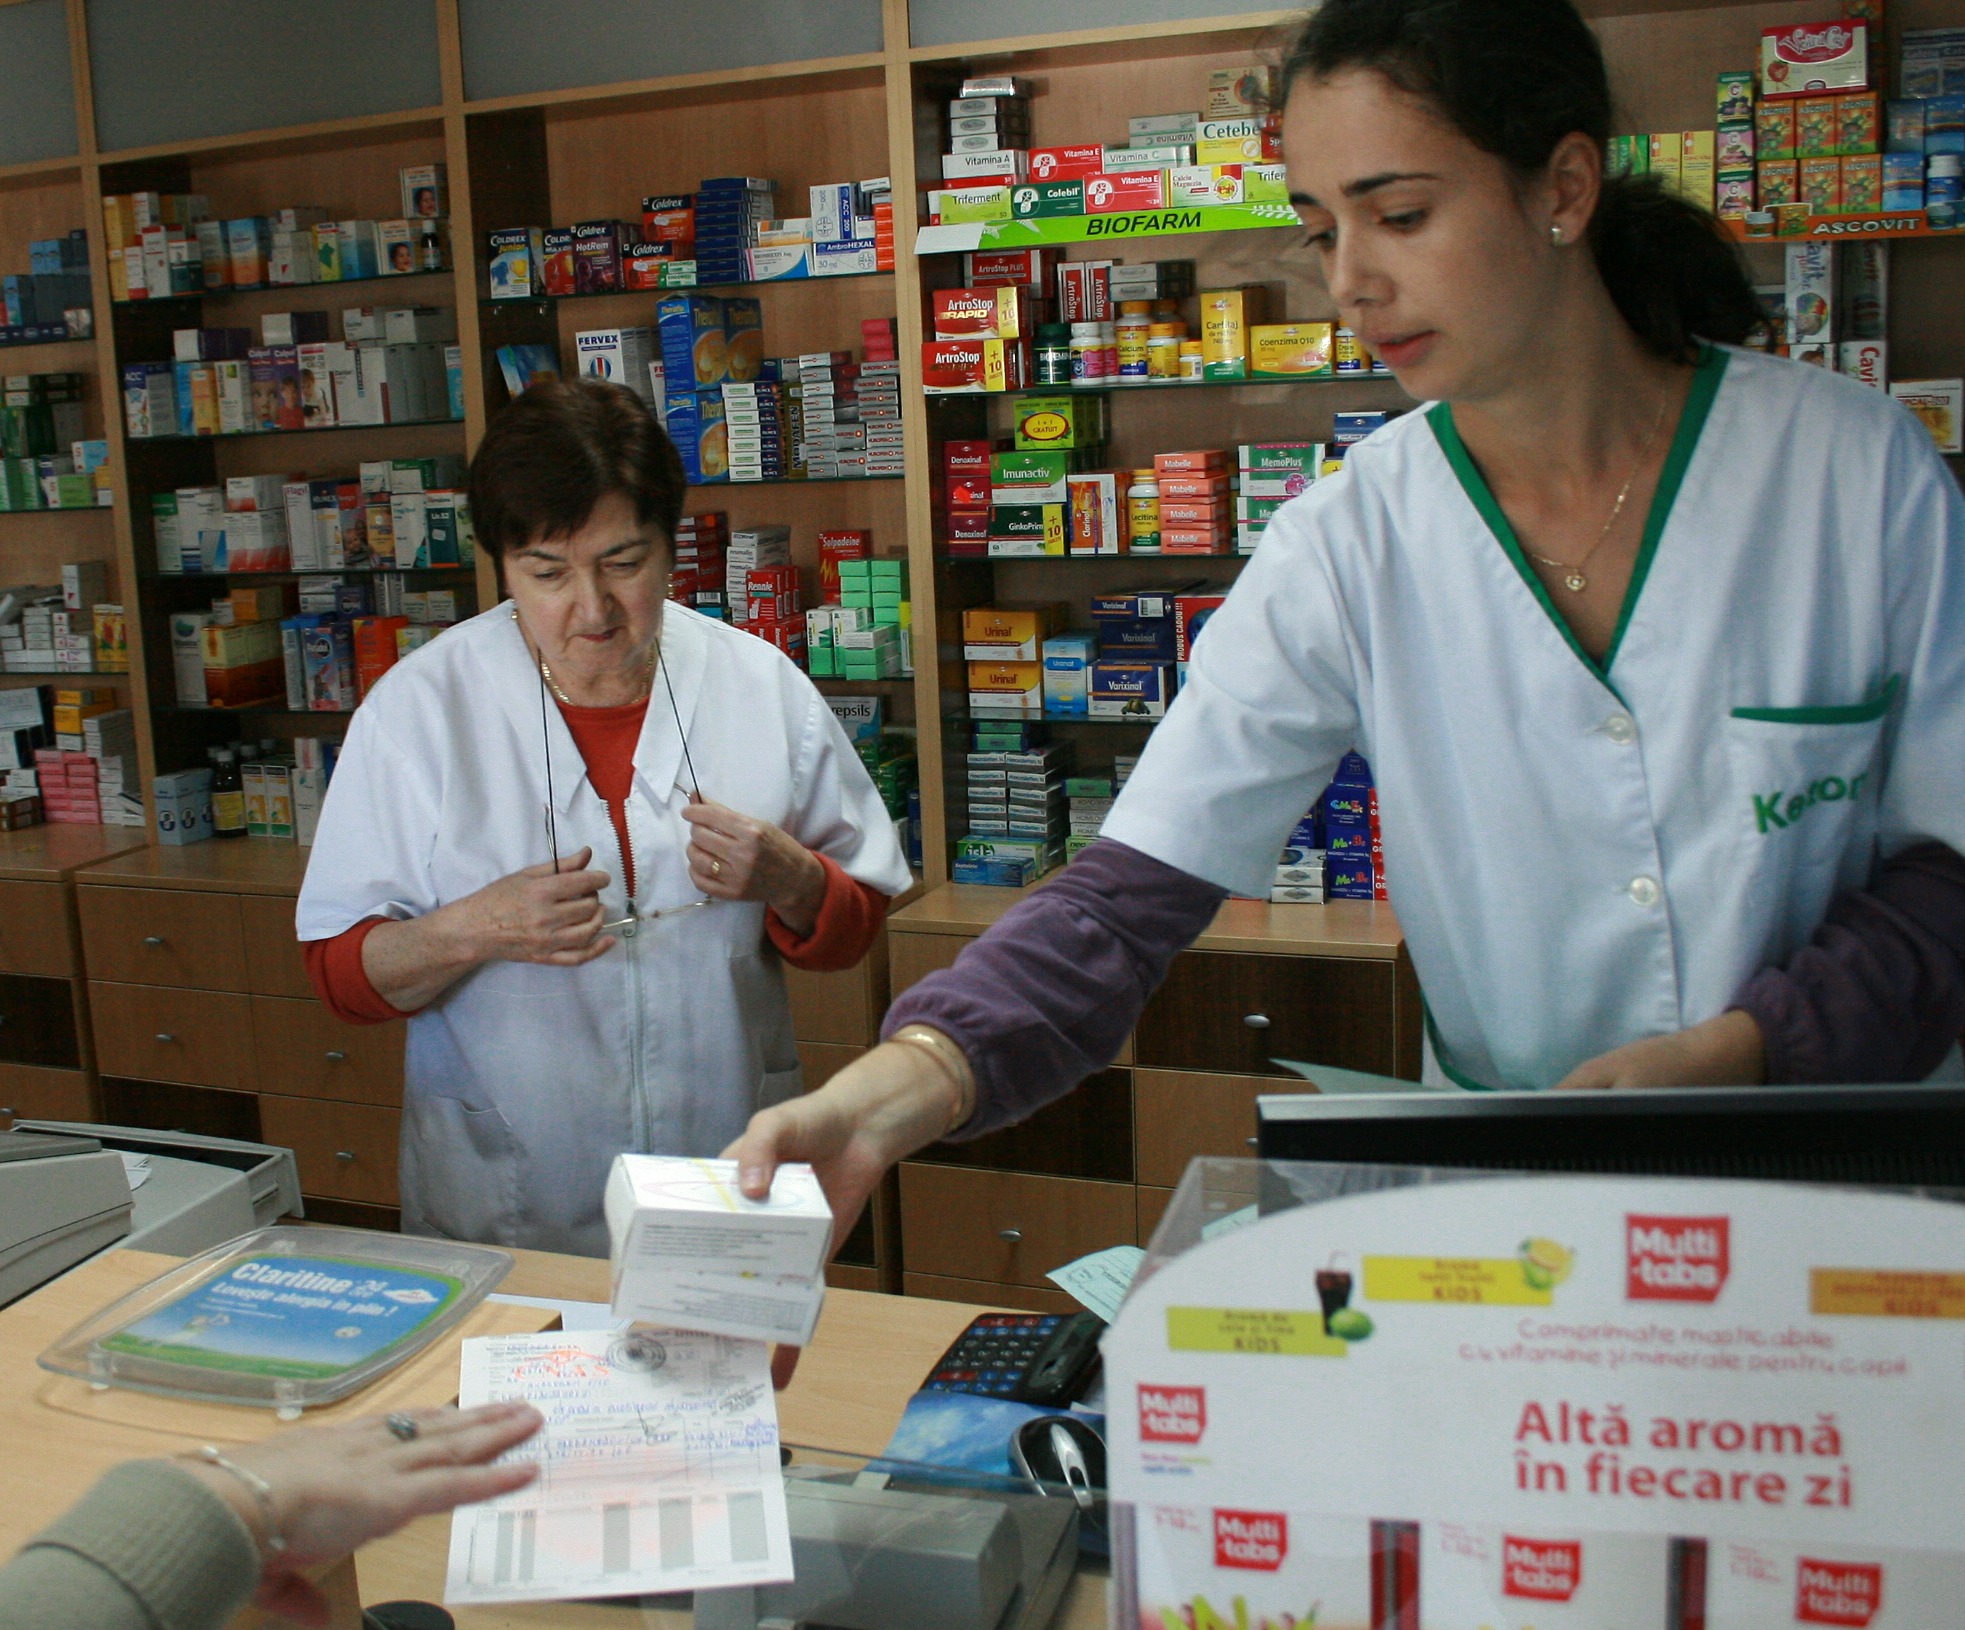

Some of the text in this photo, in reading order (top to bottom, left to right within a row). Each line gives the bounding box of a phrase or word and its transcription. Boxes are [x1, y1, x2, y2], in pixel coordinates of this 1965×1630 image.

[1064, 148, 1100, 158] Vitamina E
[1110, 150, 1160, 163] Vitamina C
[965, 154, 1010, 166] Vitamina A
[1121, 175, 1159, 185] Vitamina E
[1258, 171, 1287, 182] Trifer
[953, 190, 1001, 205] Triferment
[1047, 187, 1079, 198] Colebil
[652, 199, 683, 211] Coldrex
[1086, 211, 1201, 236] BIOFARM
[1812, 218, 1920, 235] ASCOVIT
[577, 226, 607, 238] Coldrex
[544, 234, 572, 246] COLDR
[827, 240, 874, 251] AmbroHEXAL
[576, 241, 609, 252] HotRem
[632, 244, 664, 256] Coldrex
[948, 298, 994, 311] ArtroStop
[947, 309, 988, 319] RAPID
[578, 335, 618, 345] FERVEX
[1260, 337, 1298, 347] Coenzima
[935, 351, 980, 364] ArtroStop
[989, 360, 1002, 373] 10
[1164, 459, 1192, 468] Mabelle
[1261, 457, 1302, 468] MemoPlus
[1003, 468, 1050, 479] Imunactiv
[1169, 485, 1197, 494] Mabelle
[1170, 510, 1197, 518] Mabelle
[1047, 525, 1061, 538] 10
[1171, 535, 1198, 543] Mabelle
[747, 581, 773, 591] Rennie
[985, 627, 1012, 637] Urinal
[989, 674, 1017, 684] Urinal
[1108, 680, 1143, 691] Varixinal
[1630, 1226, 1720, 1259] Multi
[231, 1262, 354, 1294] Claritine
[1432, 1285, 1483, 1302] KIDS
[1517, 1317, 1834, 1350] Comprimate masticabile
[1233, 1336, 1282, 1353] KIDS
[1458, 1343, 1491, 1361] cu
[1497, 1342, 1604, 1365] vitamine
[1628, 1347, 1744, 1371] minerale
[1747, 1350, 1835, 1374] pentru
[1141, 1392, 1199, 1414] Multi
[1515, 1400, 1844, 1458] Altă aromă
[1513, 1448, 1854, 1509] în fiecare zi
[1216, 1514, 1281, 1539] Multi
[1506, 1543, 1573, 1569] Multi
[1801, 1568, 1870, 1594] Multi
